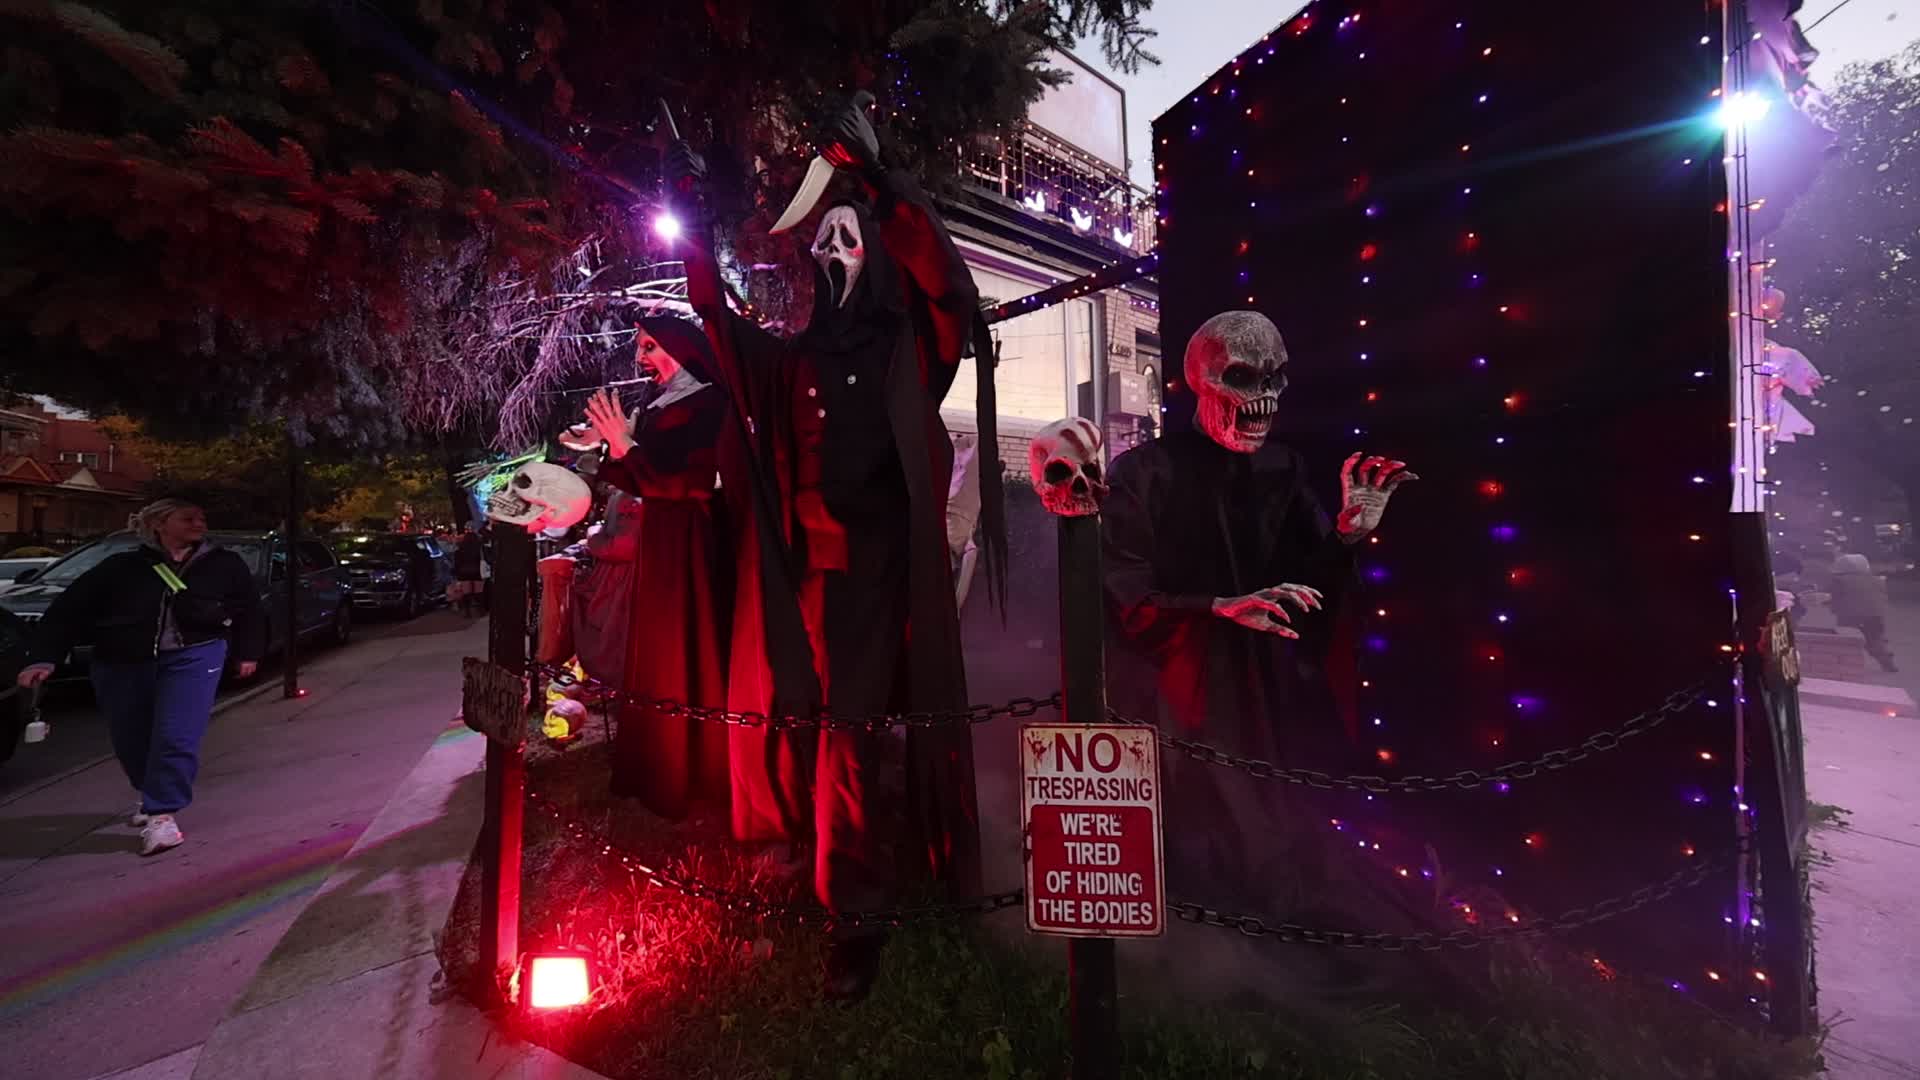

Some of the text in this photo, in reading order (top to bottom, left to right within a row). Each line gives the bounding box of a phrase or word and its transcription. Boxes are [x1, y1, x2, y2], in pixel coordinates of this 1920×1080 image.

[1055, 732, 1122, 774] NO
[1027, 776, 1153, 802] TRESPASSING
[1060, 812, 1123, 837] WE'RE
[1063, 841, 1121, 866] TIRED
[1046, 870, 1143, 896] OF HIDING
[1038, 898, 1153, 926] THE BODIES
